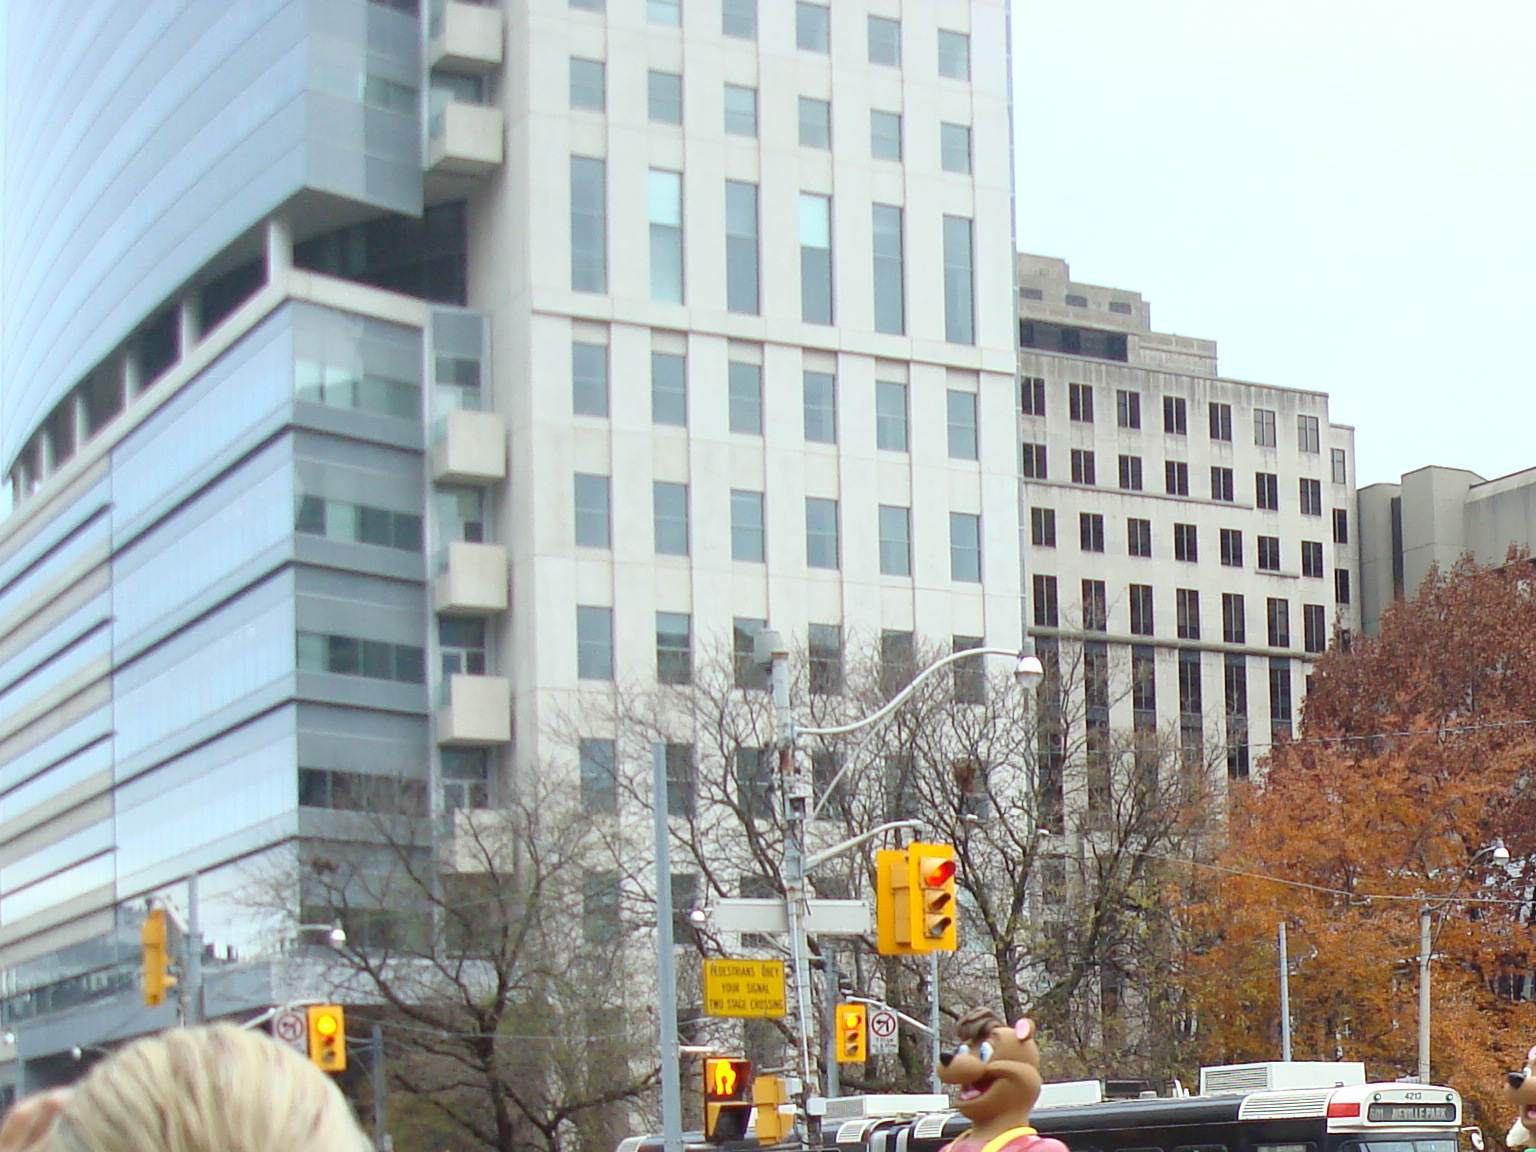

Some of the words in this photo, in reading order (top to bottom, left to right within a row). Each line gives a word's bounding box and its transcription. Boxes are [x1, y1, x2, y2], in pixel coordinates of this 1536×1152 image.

[710, 964, 756, 977] PEDESTRIANS
[761, 964, 779, 978] OBEY
[721, 982, 740, 993] YOUR
[746, 982, 770, 994] SIGNAL
[709, 999, 724, 1009] TWO
[727, 999, 747, 1010] STAGE
[750, 999, 784, 1010] CROSSING
[1425, 1107, 1447, 1120] PARK
